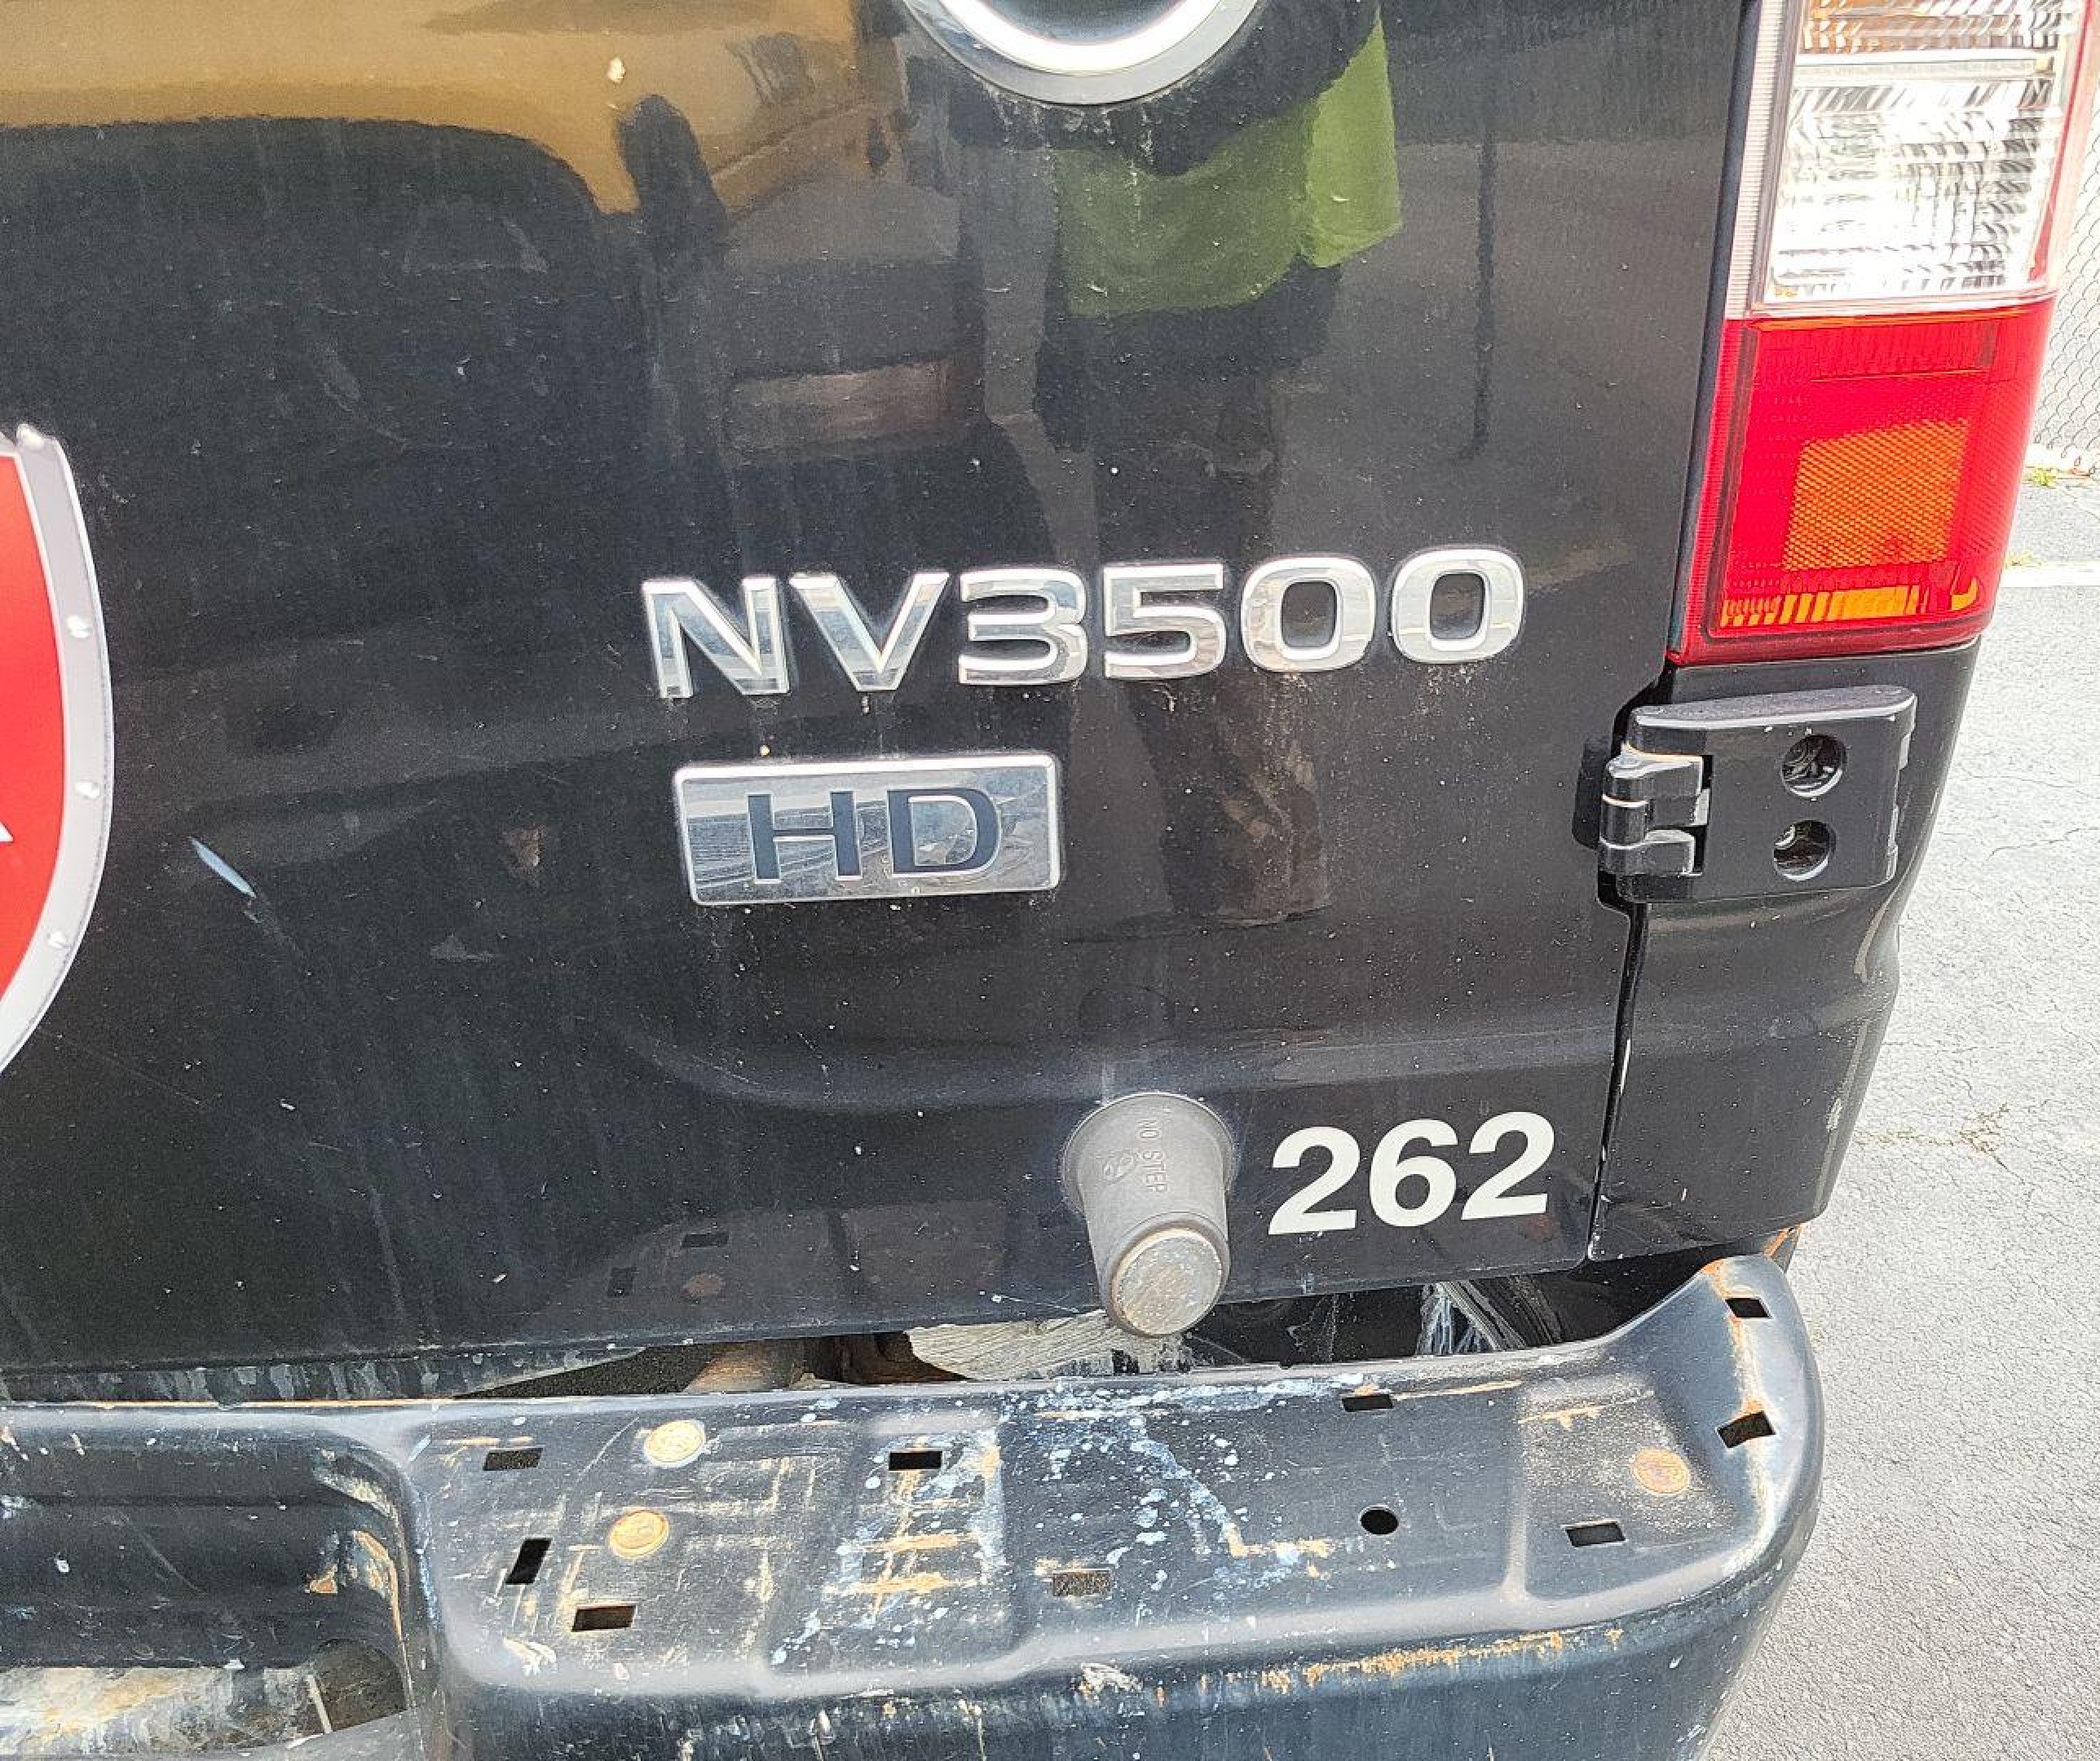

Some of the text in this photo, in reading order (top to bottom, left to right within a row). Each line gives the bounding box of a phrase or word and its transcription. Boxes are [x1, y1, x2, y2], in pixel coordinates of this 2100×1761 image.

[642, 548, 1525, 700] NV3500
[747, 788, 1003, 884] HD
[1138, 1118, 1169, 1193] NO STEP
[1268, 1111, 1555, 1235] 262
